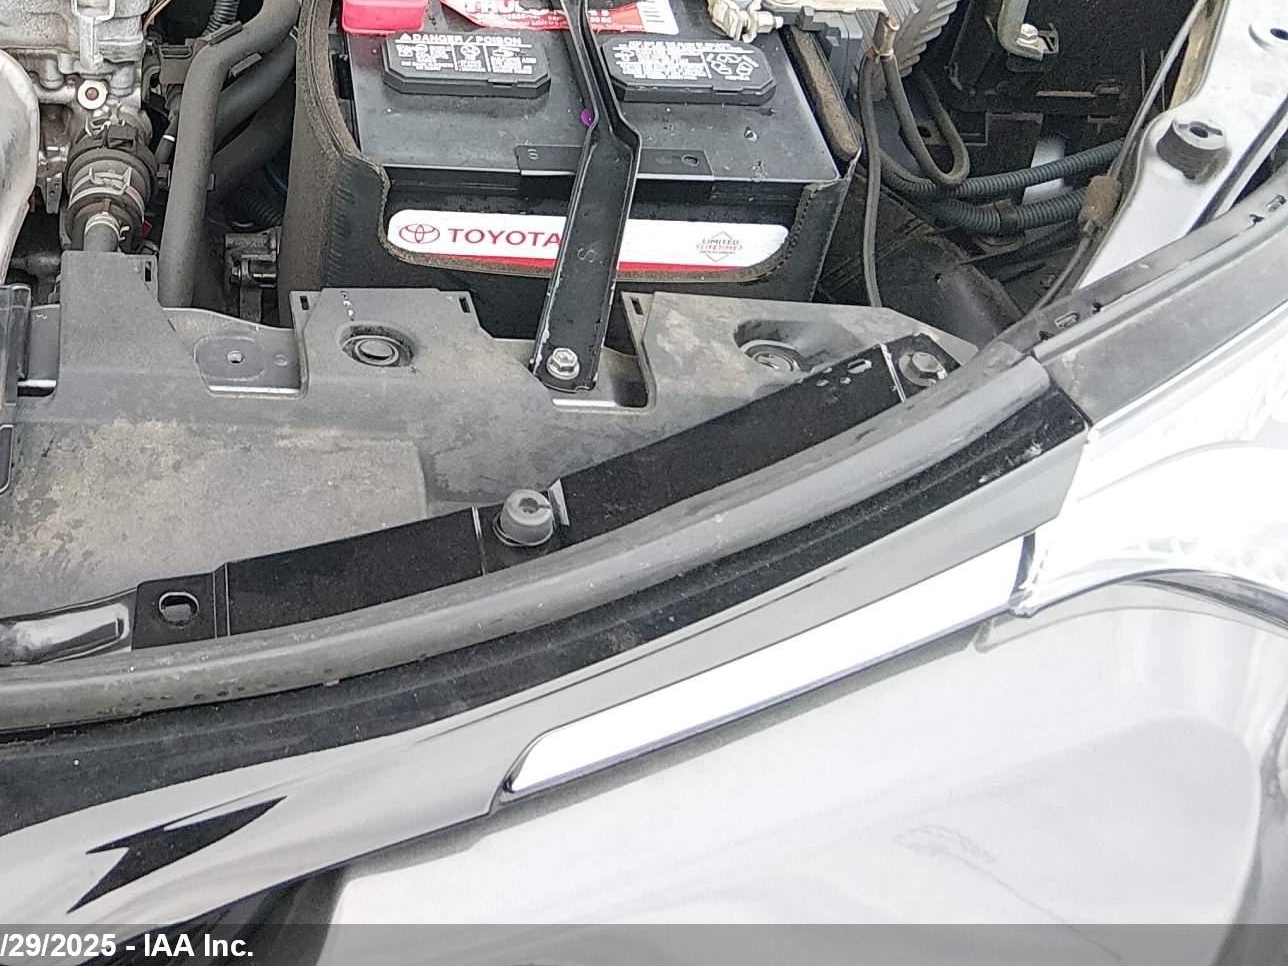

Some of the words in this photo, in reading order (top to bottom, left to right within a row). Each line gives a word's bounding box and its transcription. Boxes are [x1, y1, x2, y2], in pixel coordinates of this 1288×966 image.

[412, 32, 463, 43] DANGER
[476, 35, 522, 45] POISON
[447, 226, 562, 248] TOYOTA
[701, 237, 740, 246] LIMITED
